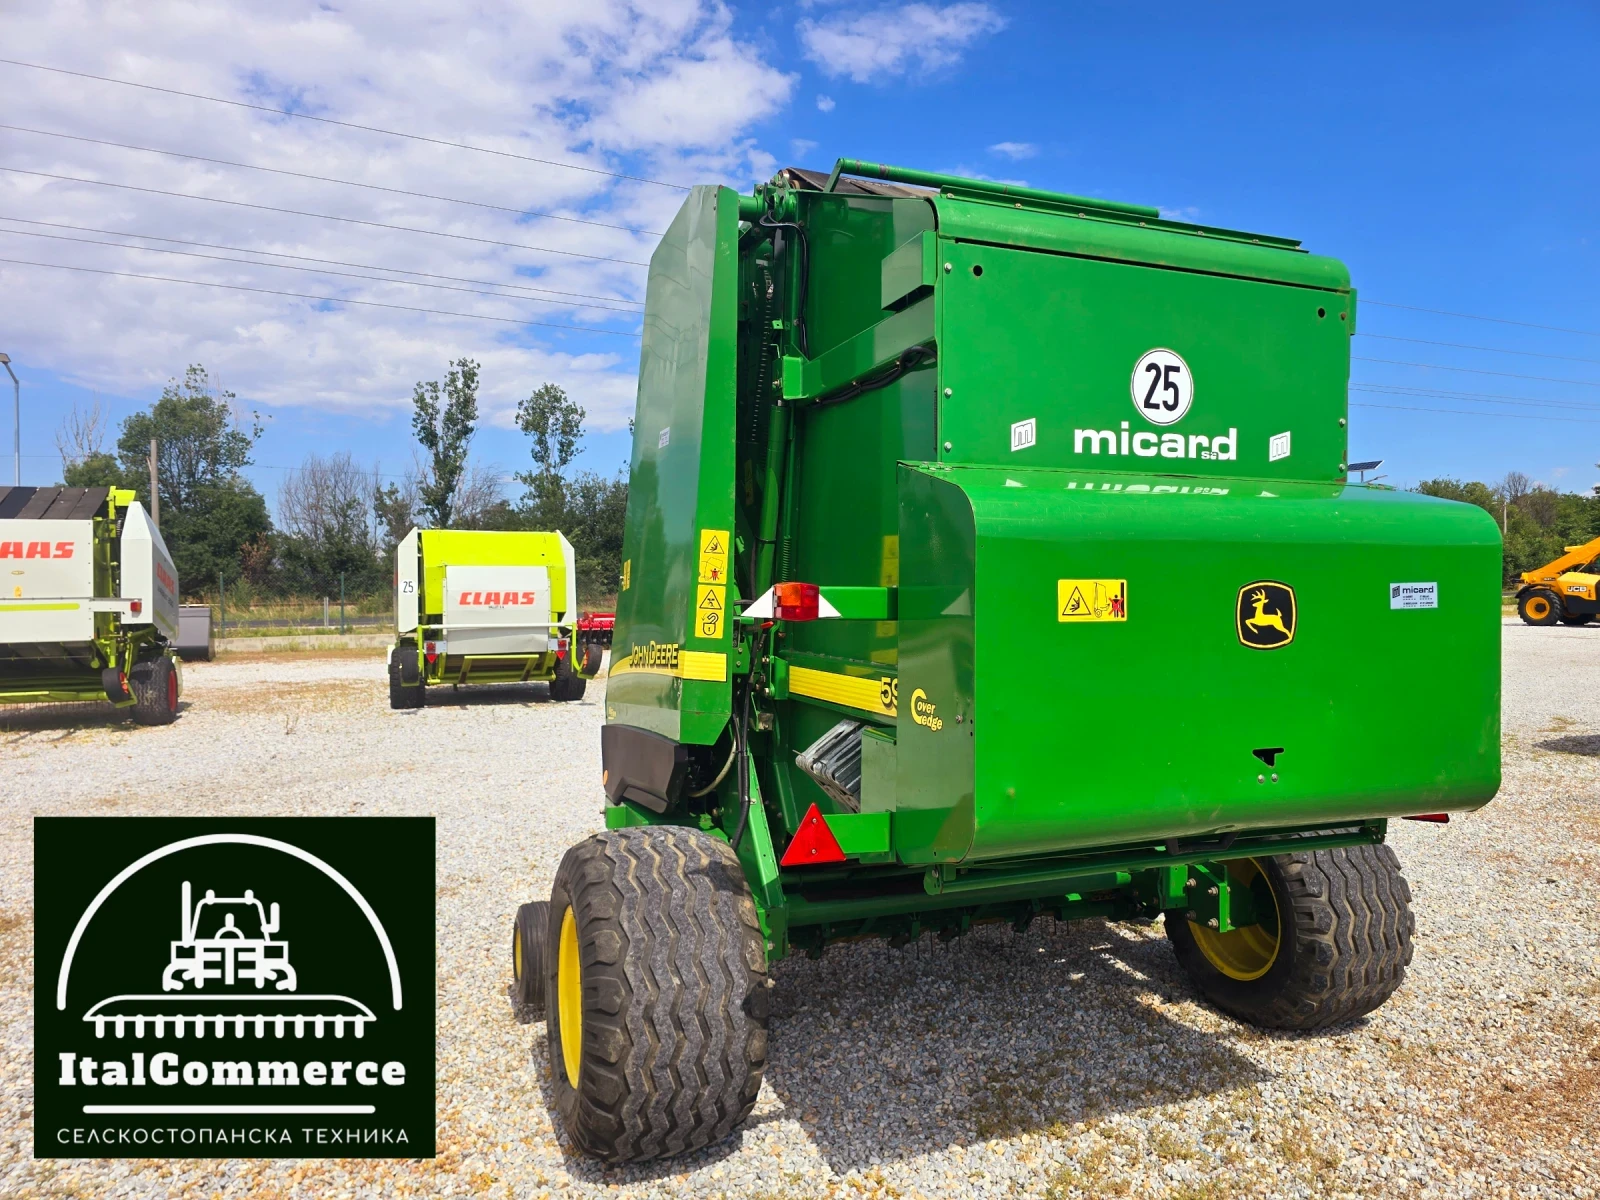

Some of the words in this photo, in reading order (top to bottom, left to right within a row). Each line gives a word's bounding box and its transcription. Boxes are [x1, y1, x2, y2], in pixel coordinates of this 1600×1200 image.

[1143, 362, 1181, 412] 25
[1073, 420, 1237, 461] micard
[403, 580, 414, 593] 25
[1402, 585, 1434, 594] micard
[459, 591, 536, 606] CLAAS
[649, 640, 679, 669] DEERE
[911, 688, 936, 725] Cover
[921, 714, 943, 732] edge
